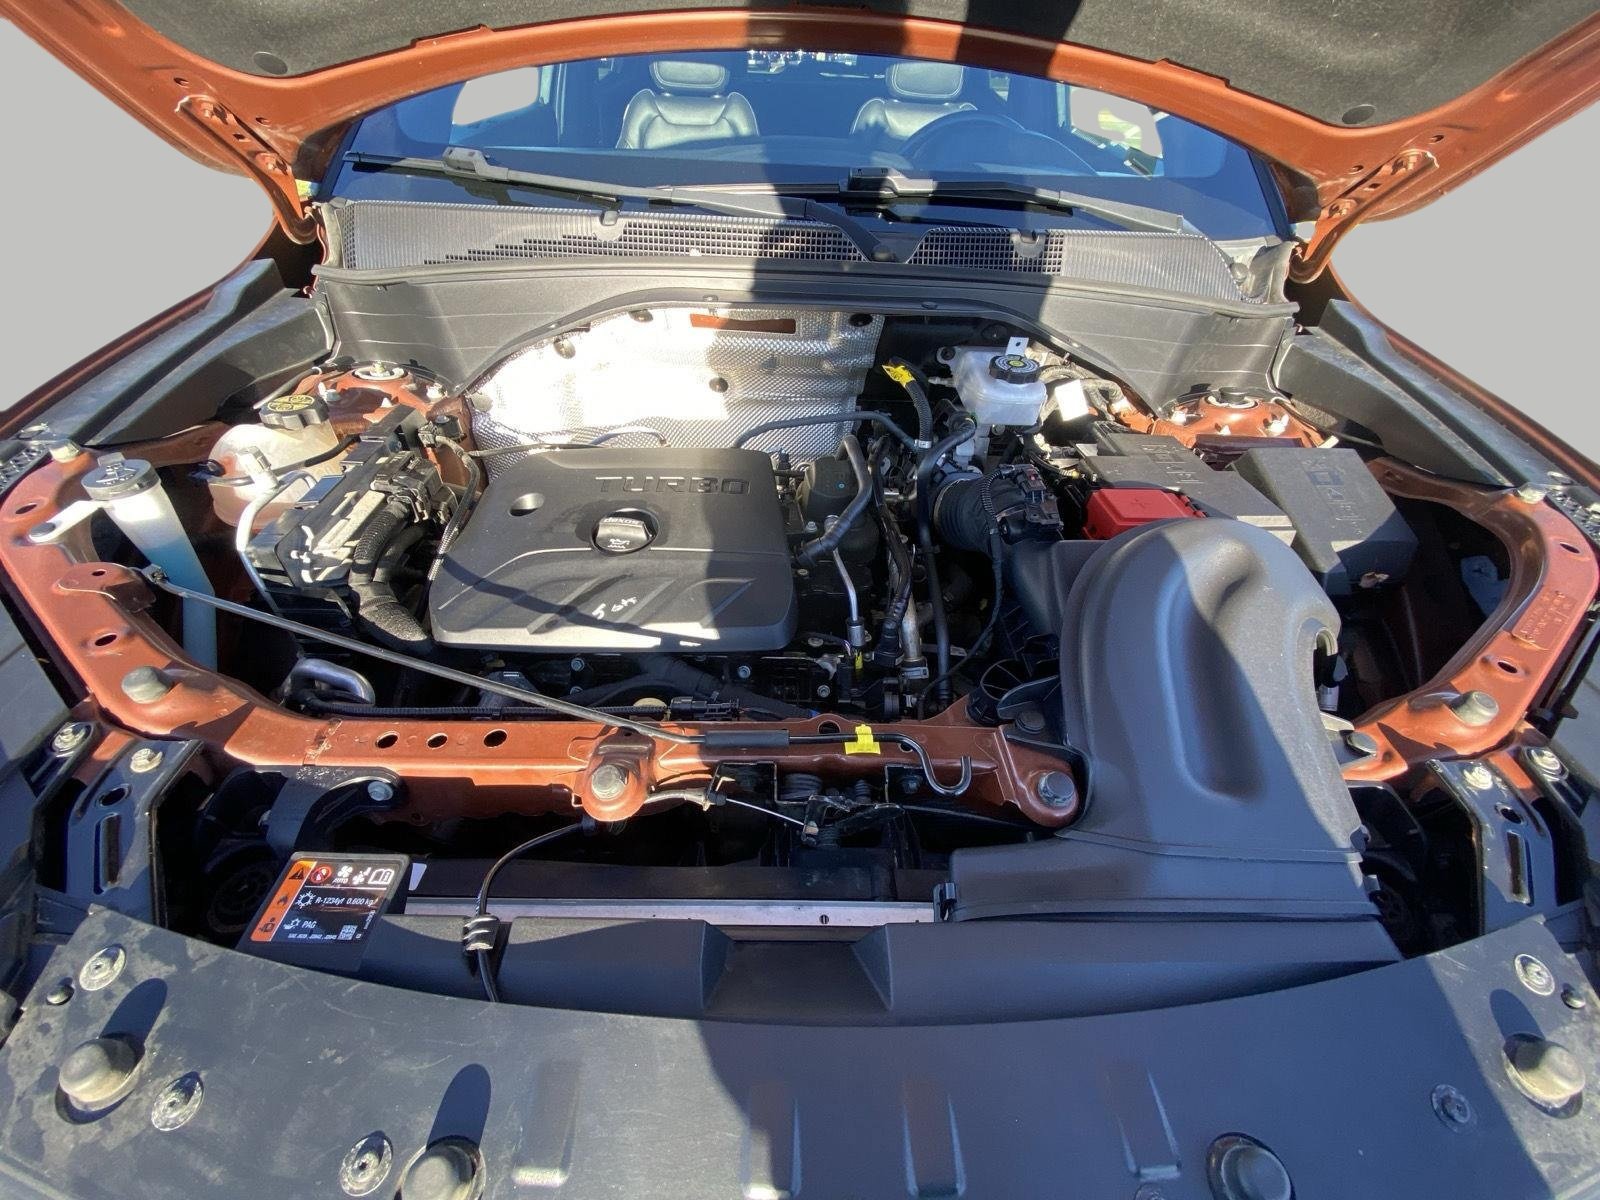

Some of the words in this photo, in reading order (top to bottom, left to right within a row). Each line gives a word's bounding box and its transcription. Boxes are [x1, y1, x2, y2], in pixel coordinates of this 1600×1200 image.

[595, 476, 751, 495] TURBO
[315, 897, 345, 905] R-1234yf
[301, 921, 317, 929] PAG
